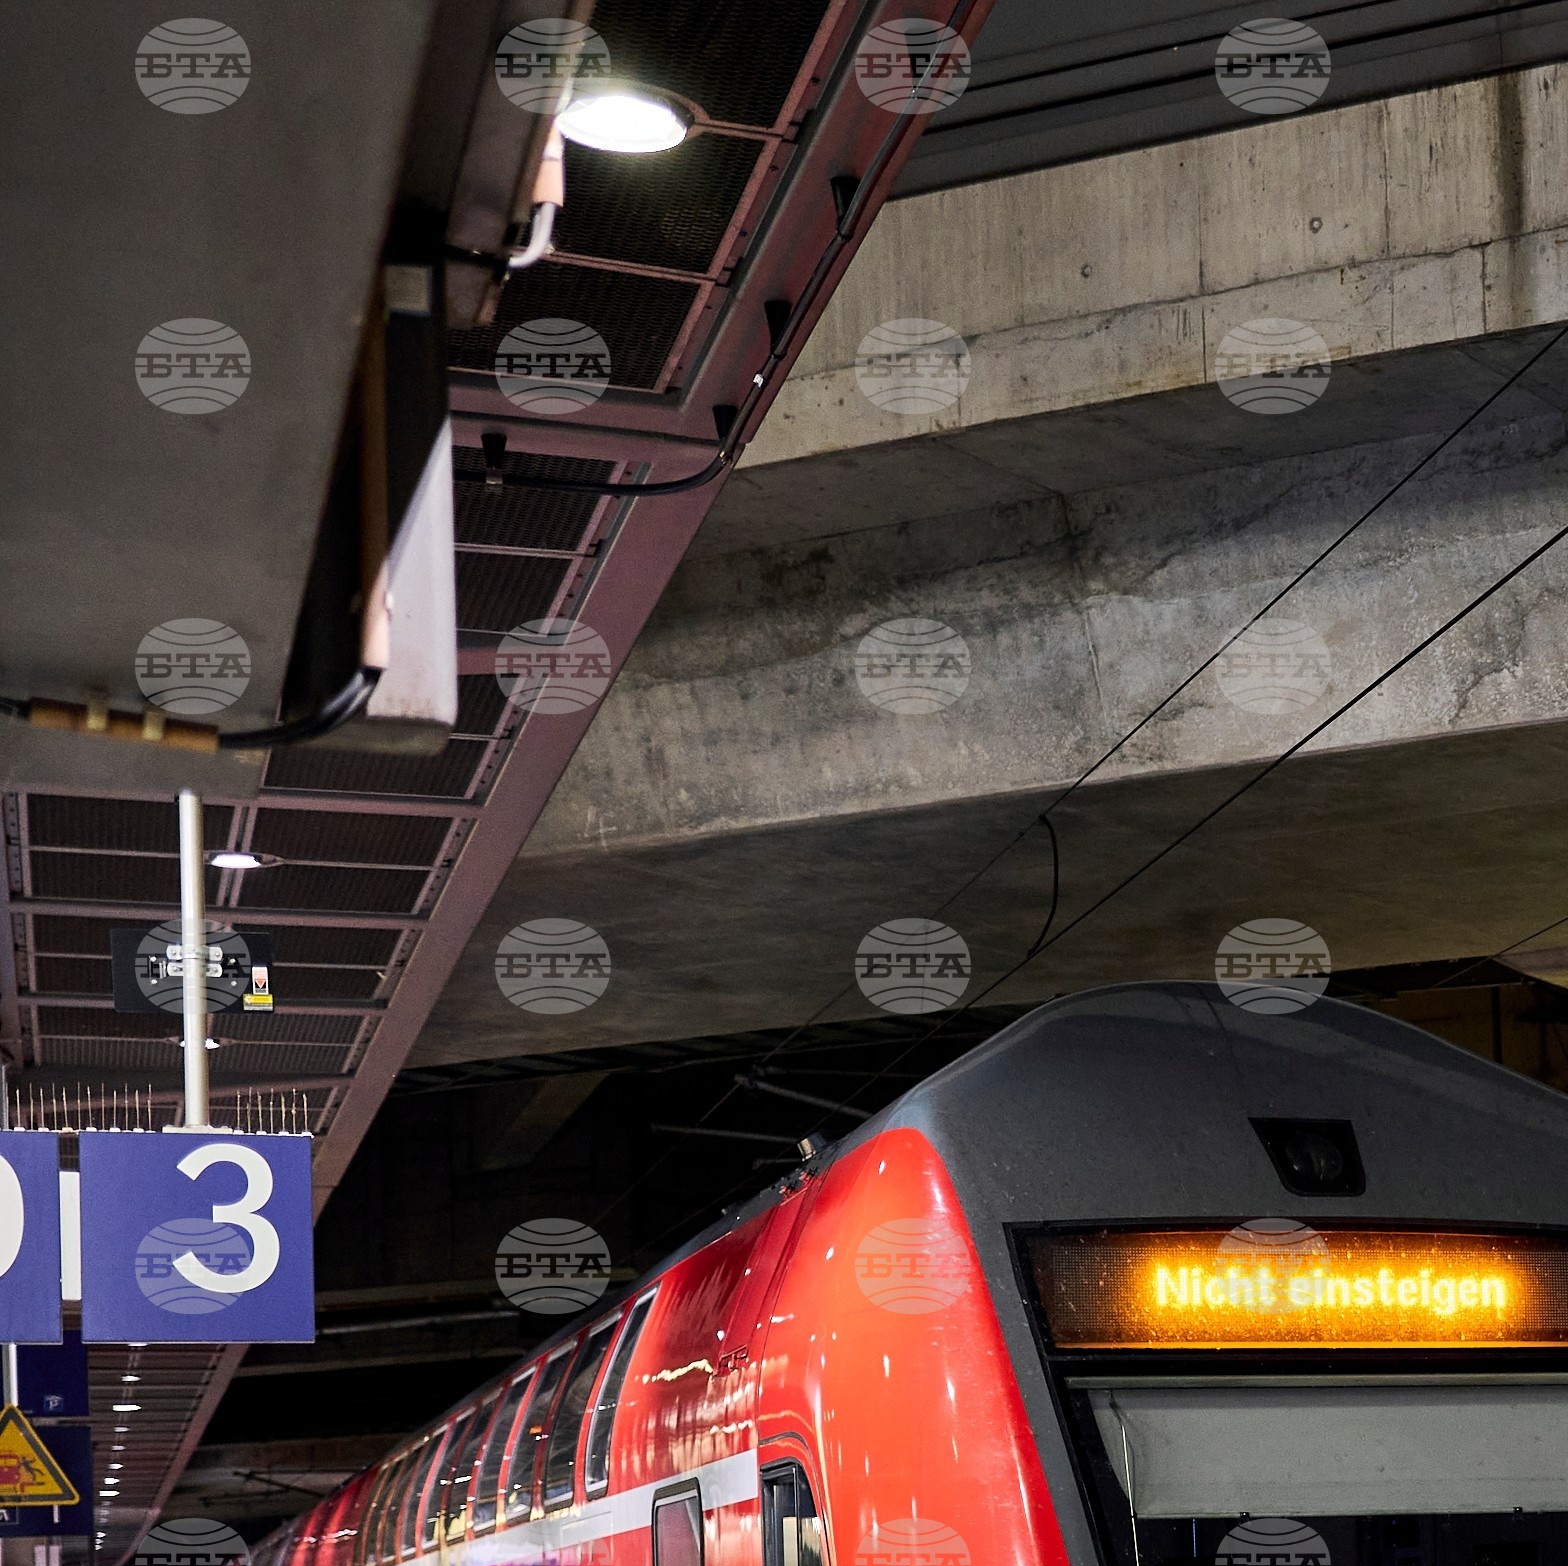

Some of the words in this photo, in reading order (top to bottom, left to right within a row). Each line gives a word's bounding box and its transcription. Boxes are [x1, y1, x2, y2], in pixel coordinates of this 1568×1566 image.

[172, 1143, 280, 1293] 3
[1155, 1266, 1277, 1307] Nicht
[1288, 1266, 1506, 1316] einsteigen
